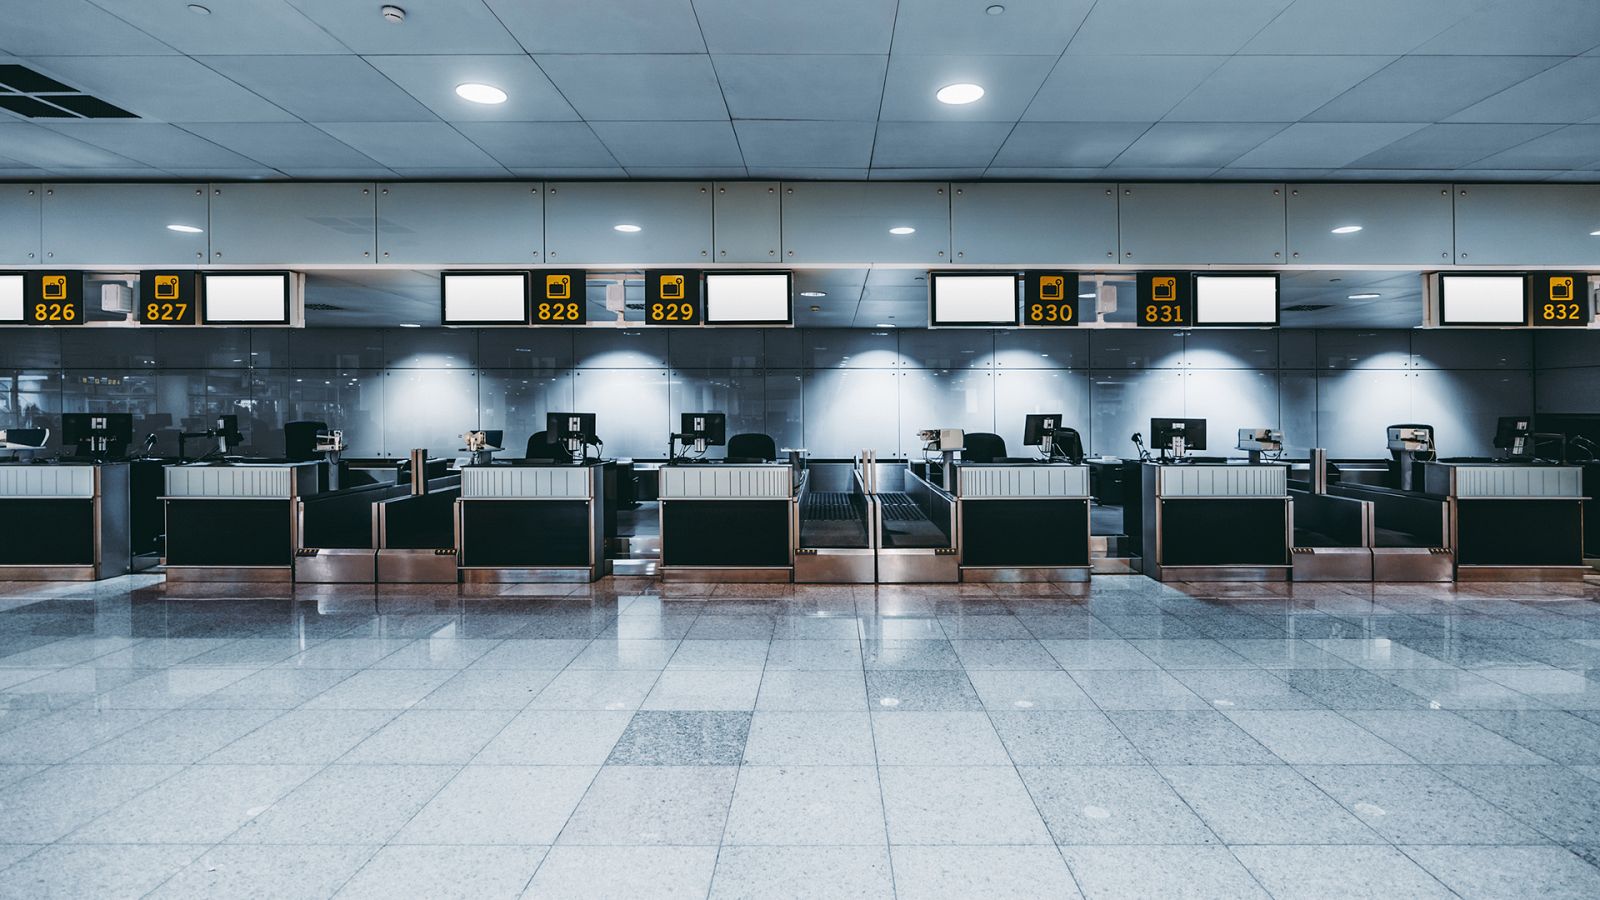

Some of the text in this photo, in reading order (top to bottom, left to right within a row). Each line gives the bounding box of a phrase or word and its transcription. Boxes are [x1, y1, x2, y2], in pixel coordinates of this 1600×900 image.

[35, 304, 75, 320] 826
[147, 304, 188, 320] 827
[539, 303, 579, 320] 828
[652, 304, 693, 320] 829
[1031, 304, 1072, 321] 830
[1145, 304, 1183, 321] 831
[1543, 304, 1580, 320] 832
